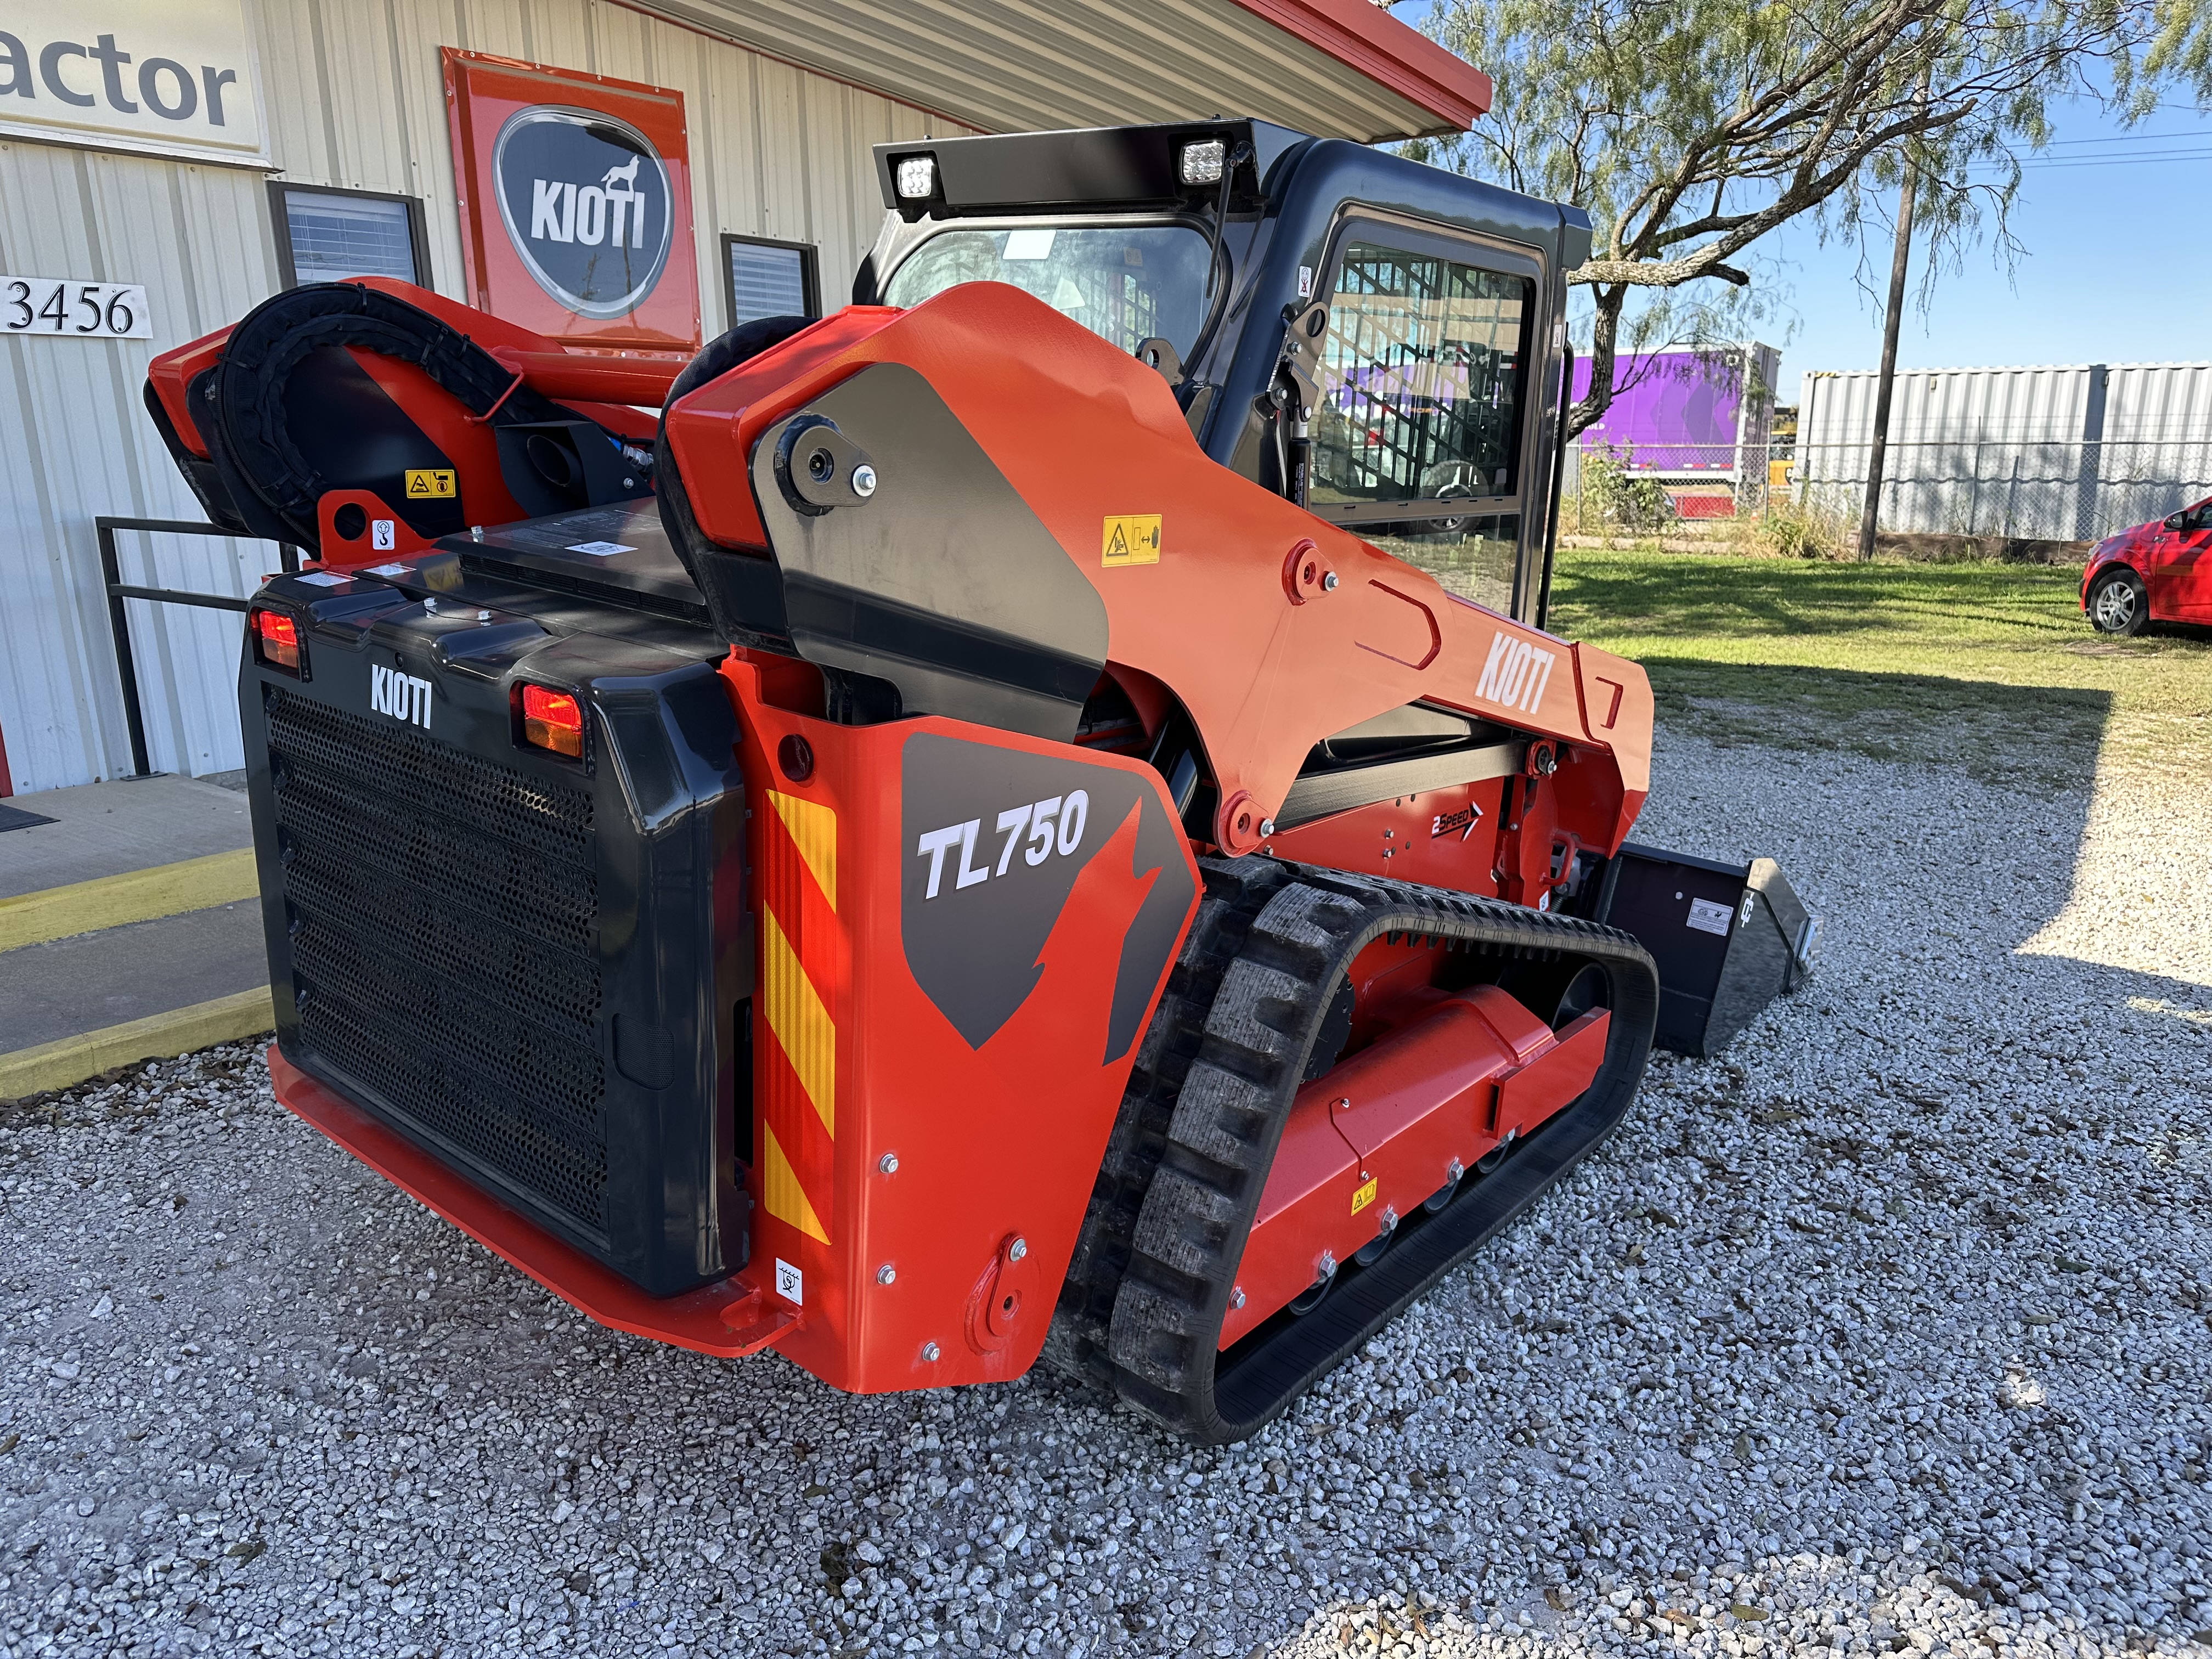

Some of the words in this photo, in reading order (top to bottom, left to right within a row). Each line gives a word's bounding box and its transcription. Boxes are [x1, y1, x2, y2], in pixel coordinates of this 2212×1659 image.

[0, 30, 236, 127] actor
[531, 179, 645, 249] KIOTI
[8, 281, 133, 334] 3456
[371, 664, 432, 730] KIOTI
[1475, 631, 1555, 714] KIOTI
[917, 789, 1090, 901] TL750
